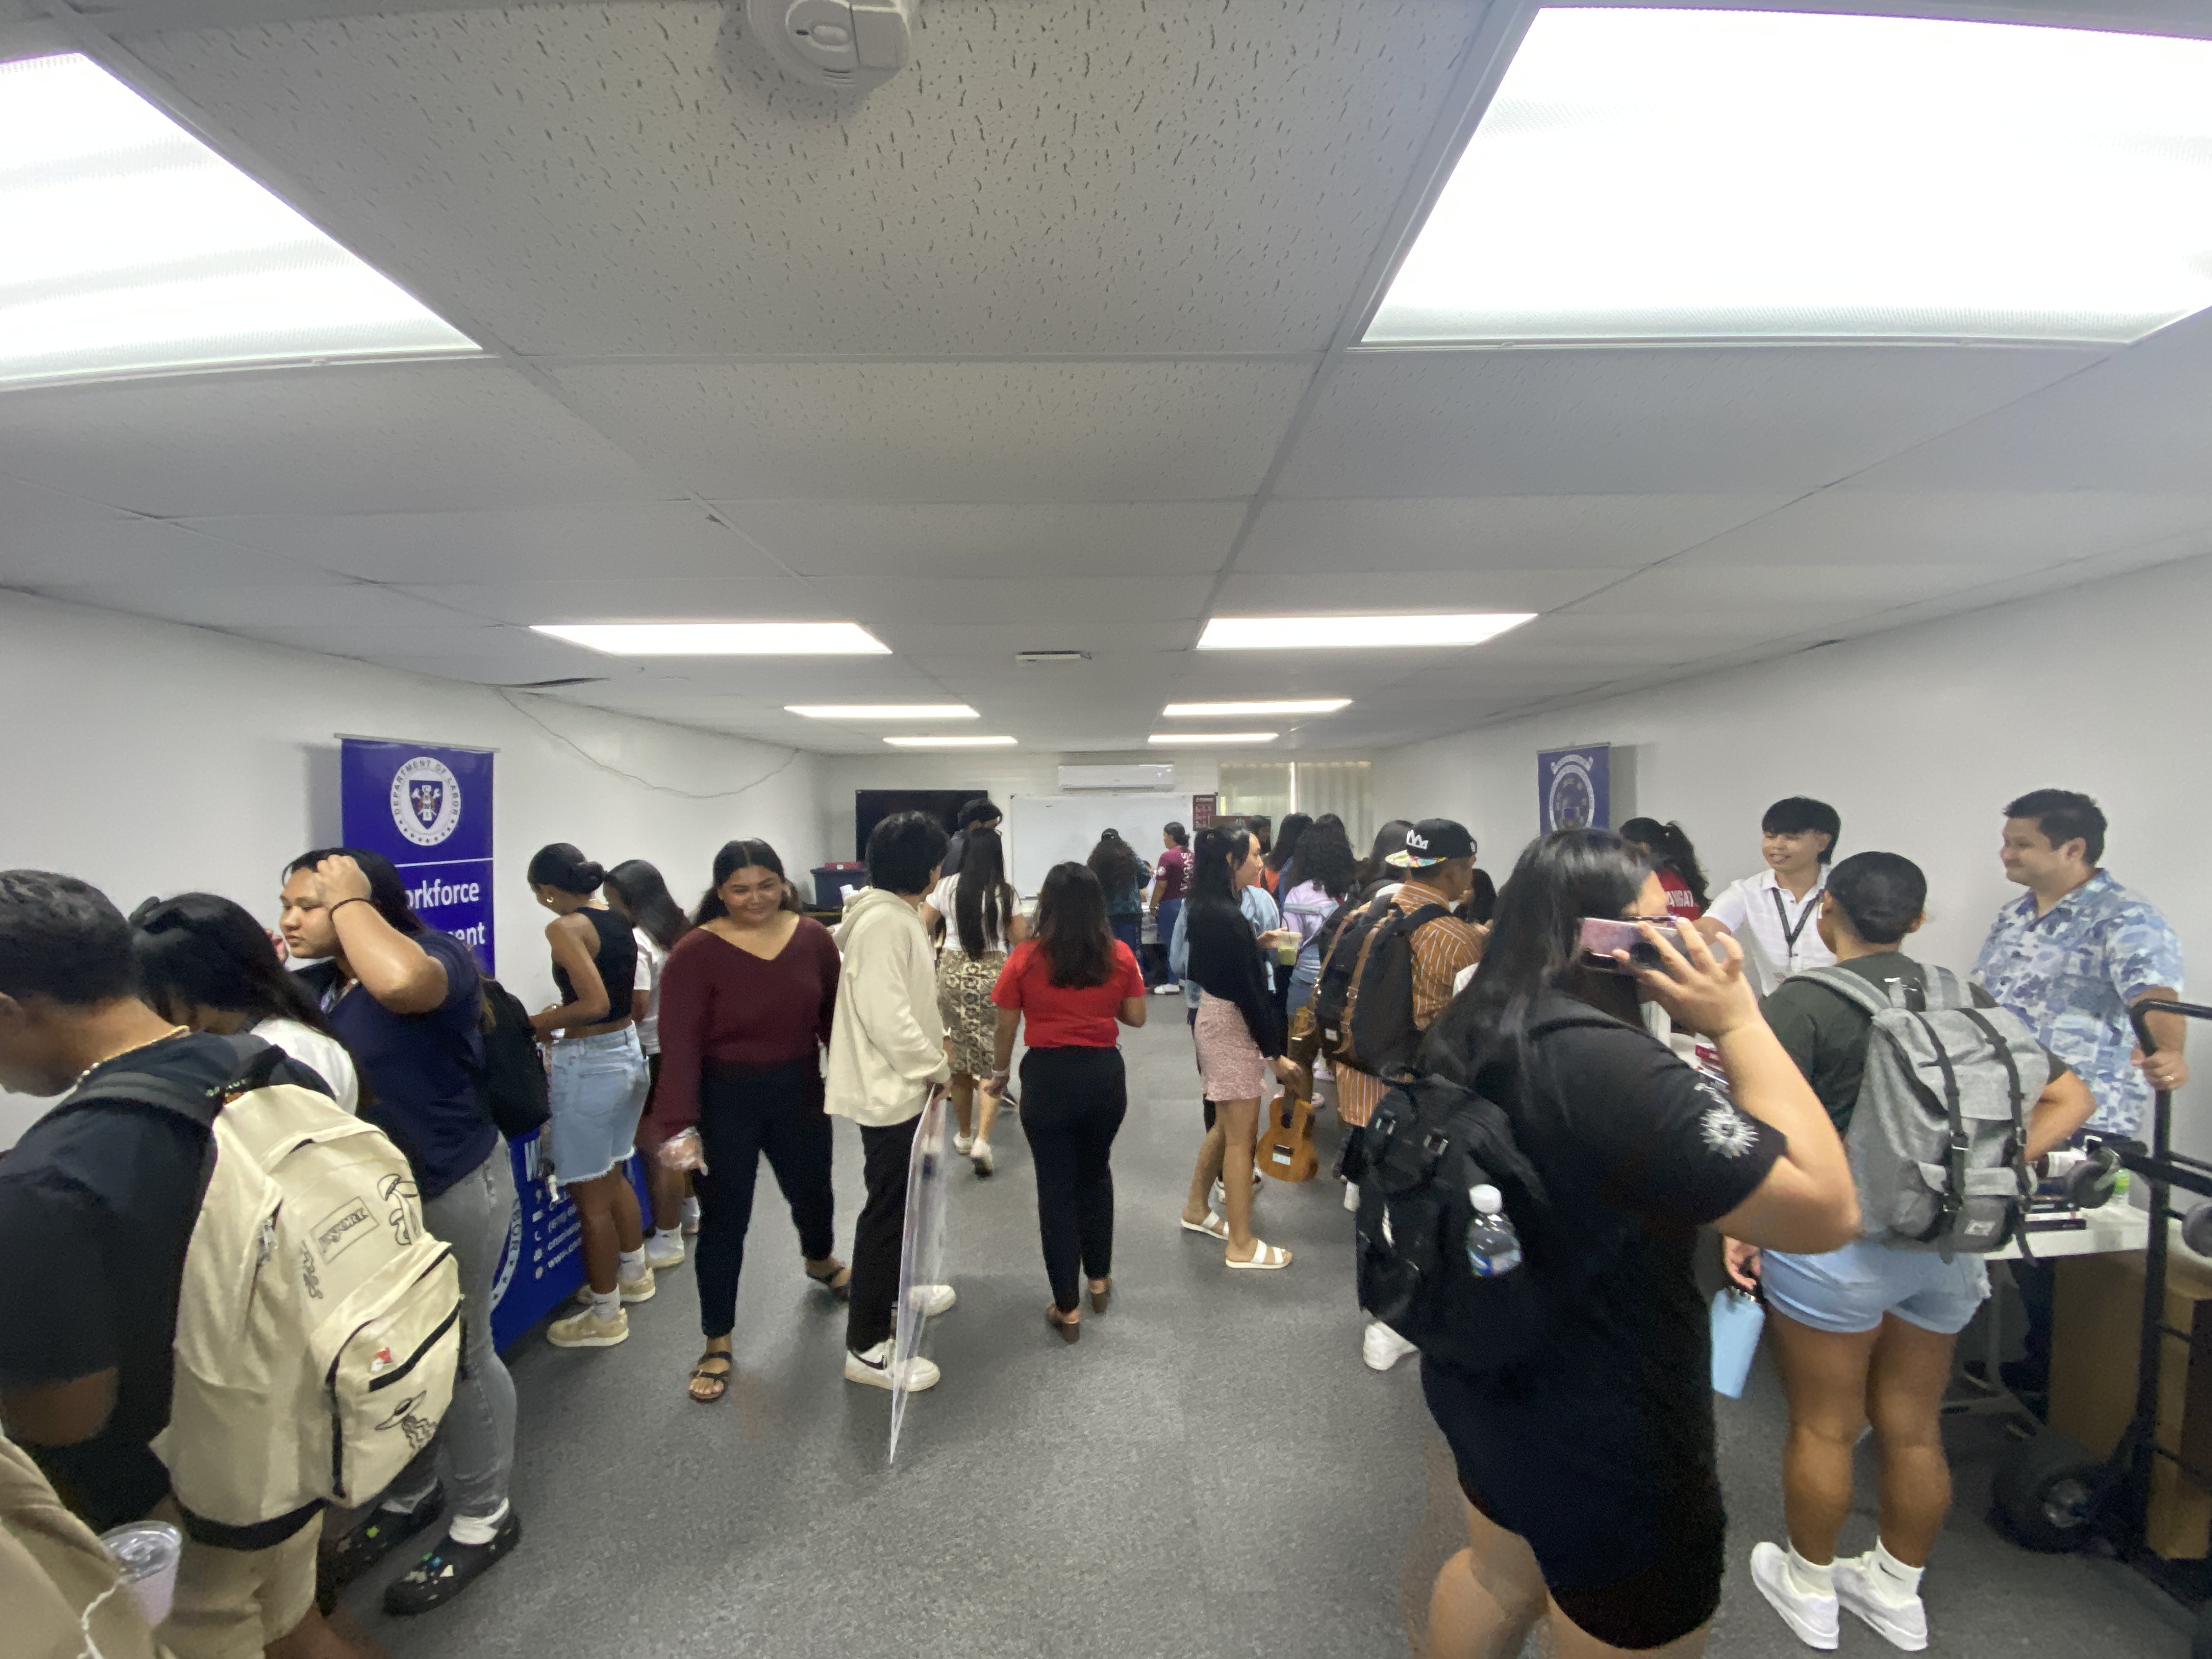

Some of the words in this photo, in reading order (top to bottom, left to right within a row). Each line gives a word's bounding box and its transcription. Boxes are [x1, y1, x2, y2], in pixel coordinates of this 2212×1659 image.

[393, 760, 431, 815] DEPARTMENT
[435, 764, 447, 774] OF
[447, 777, 459, 815] LABOR
[405, 879, 479, 909] orkforce
[448, 922, 485, 945] ent
